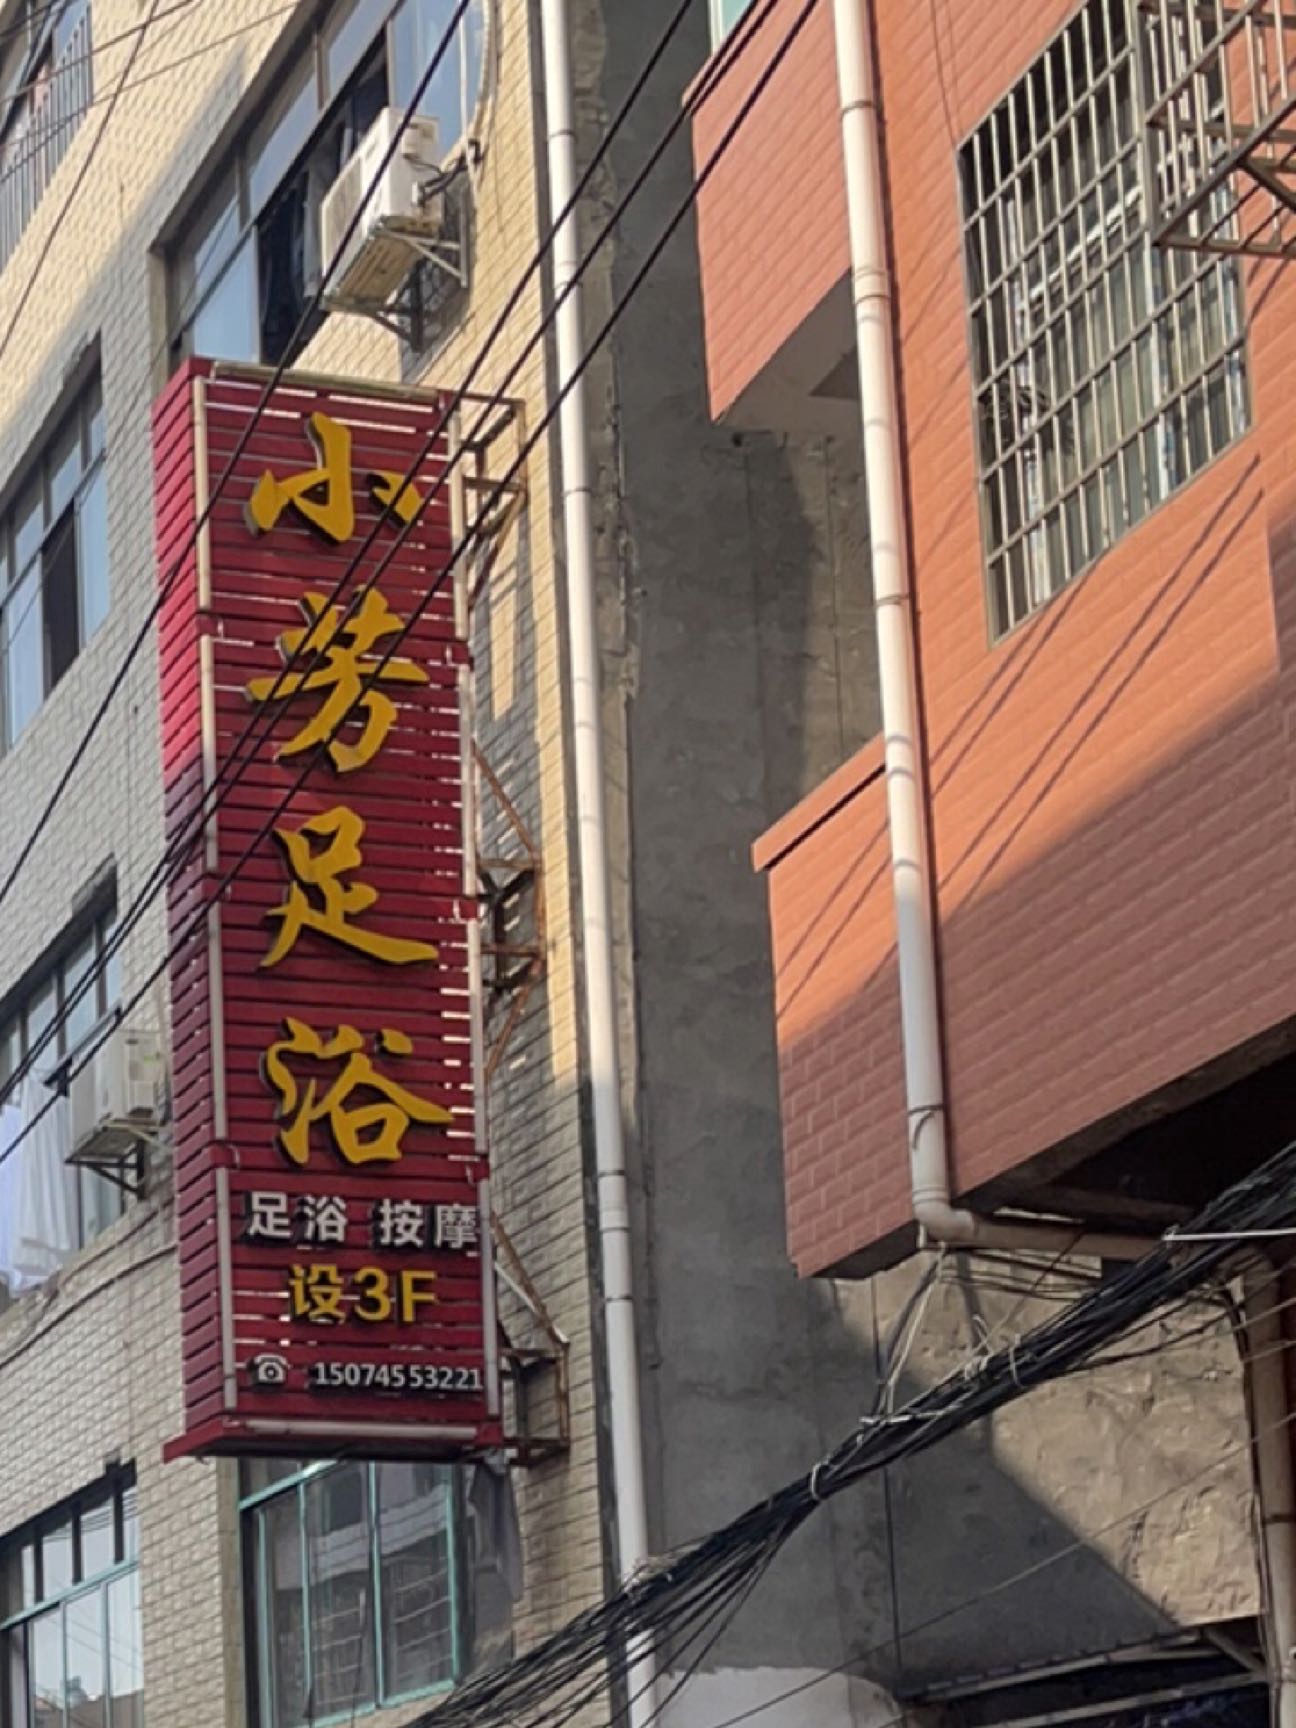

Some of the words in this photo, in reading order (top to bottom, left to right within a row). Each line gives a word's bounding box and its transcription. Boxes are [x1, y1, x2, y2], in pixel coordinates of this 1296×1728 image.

[245, 411, 454, 1164] 小芳足浴
[289, 1264, 438, 1323] 设3F
[313, 1362, 483, 1391] 15074553221
